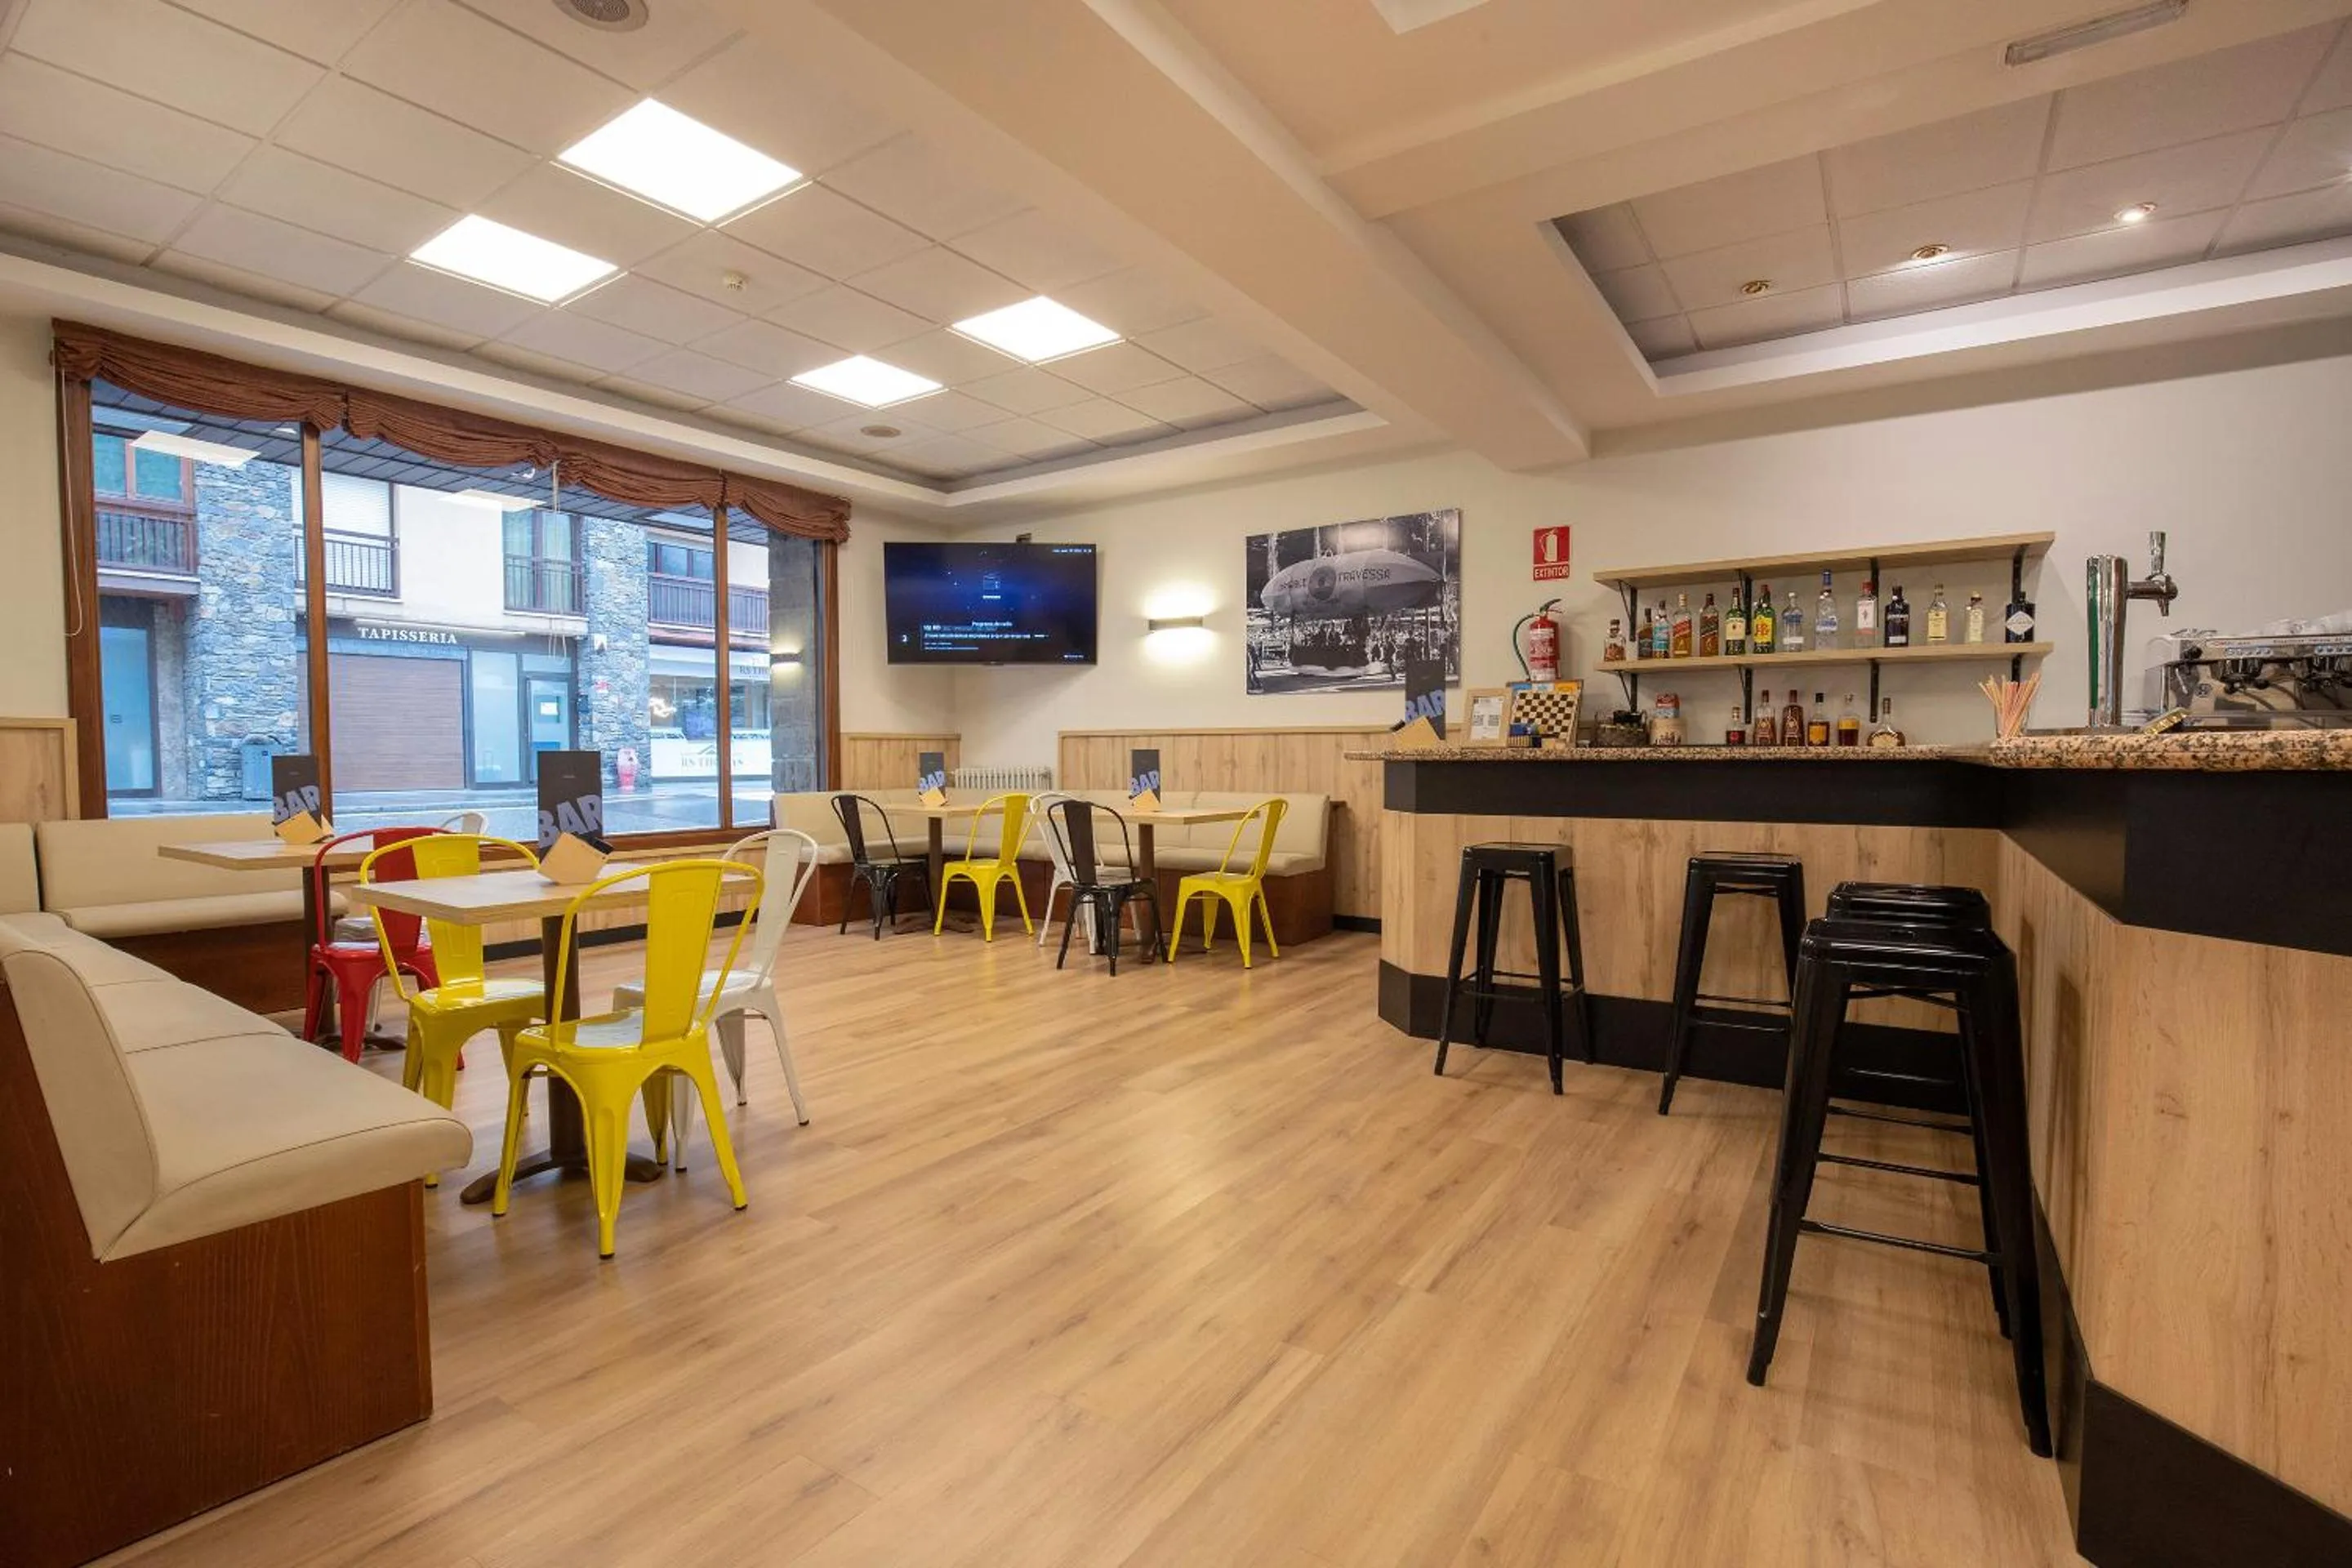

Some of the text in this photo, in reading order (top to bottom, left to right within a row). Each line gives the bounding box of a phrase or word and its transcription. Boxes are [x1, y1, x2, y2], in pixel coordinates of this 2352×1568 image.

[1338, 568, 1391, 582] TRAVESSA
[1535, 565, 1569, 578] EXTINTOR
[358, 627, 457, 644] TAPISSERIA
[1405, 689, 1445, 723] BAR
[919, 771, 945, 791] BAR
[1129, 770, 1160, 795] BAR
[273, 785, 320, 824] BAR
[538, 795, 602, 848] BAR
